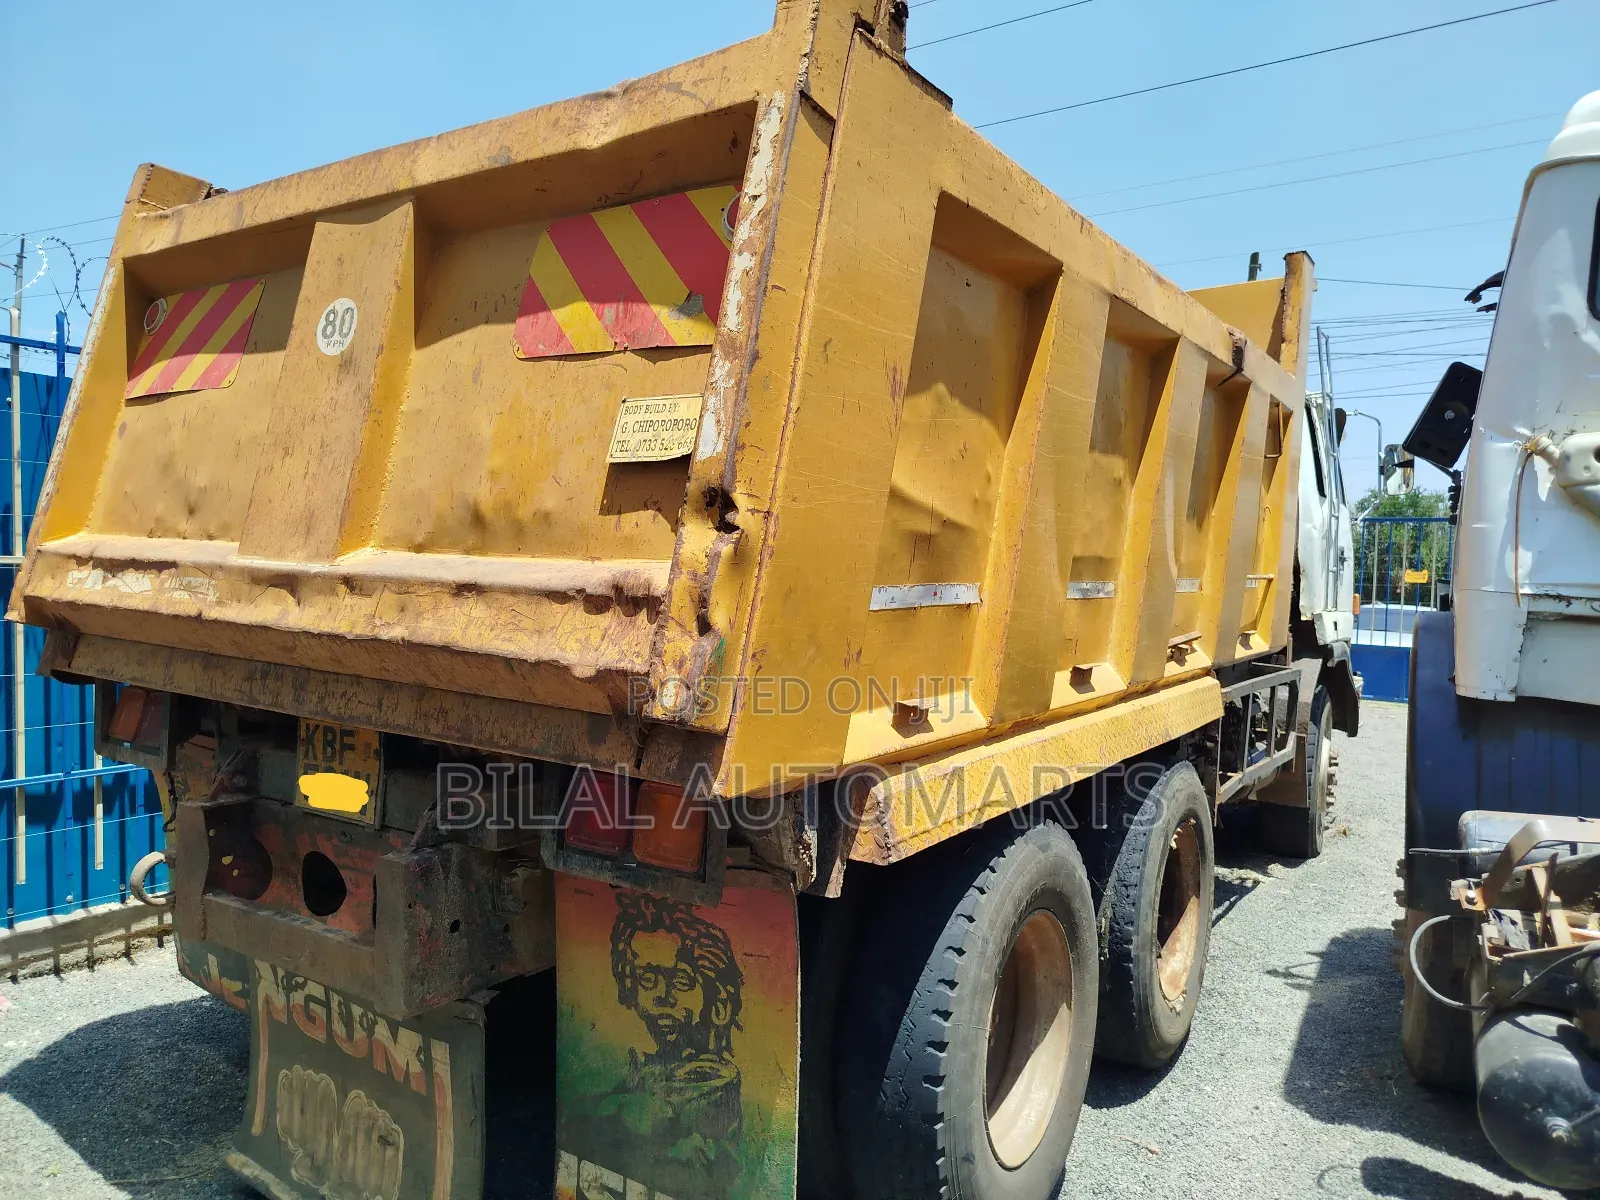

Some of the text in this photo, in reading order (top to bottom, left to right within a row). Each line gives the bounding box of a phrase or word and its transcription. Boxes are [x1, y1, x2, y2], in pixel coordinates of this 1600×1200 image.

[321, 306, 355, 339] 80
[326, 339, 345, 348] KPH
[624, 405, 644, 415] BODY
[644, 403, 667, 414] BUILD
[621, 421, 630, 434] G.
[303, 722, 356, 766] KBF
